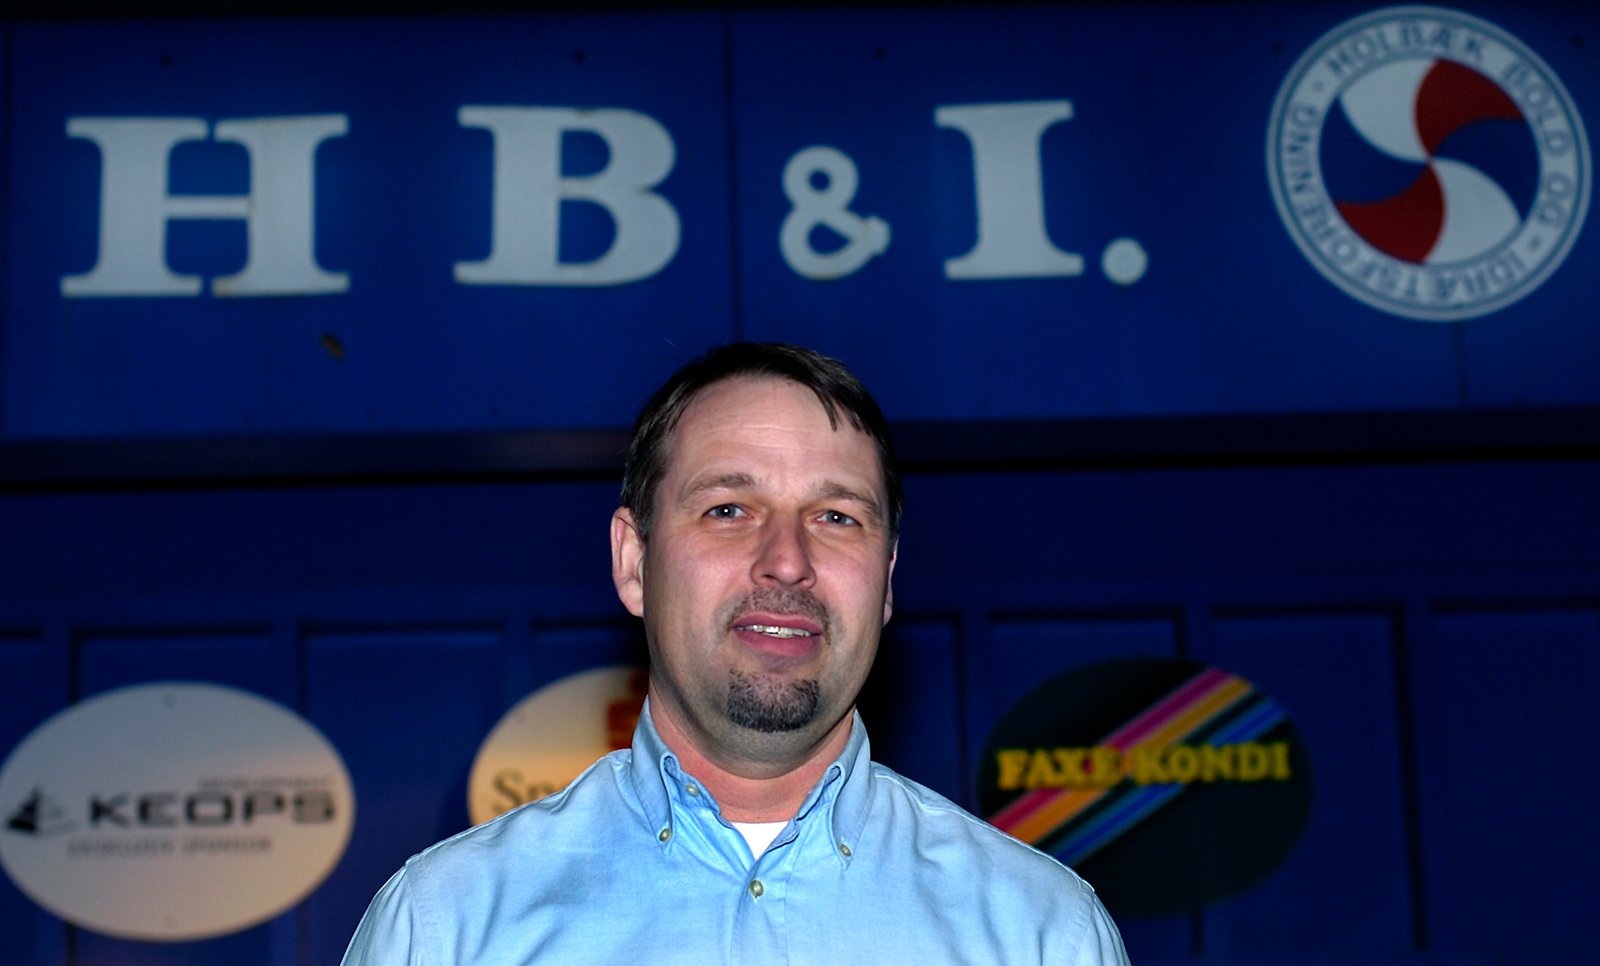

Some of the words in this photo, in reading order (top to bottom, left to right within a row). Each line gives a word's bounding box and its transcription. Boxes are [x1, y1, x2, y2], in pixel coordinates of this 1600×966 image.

[1501, 61, 1571, 156] BOLD
[1536, 174, 1571, 228] OG
[61, 113, 350, 297] H
[454, 105, 682, 286] B
[778, 144, 892, 282] &
[89, 790, 337, 828] KEOPS
[998, 746, 1122, 789] FAXE
[1131, 742, 1292, 785] KONDI
